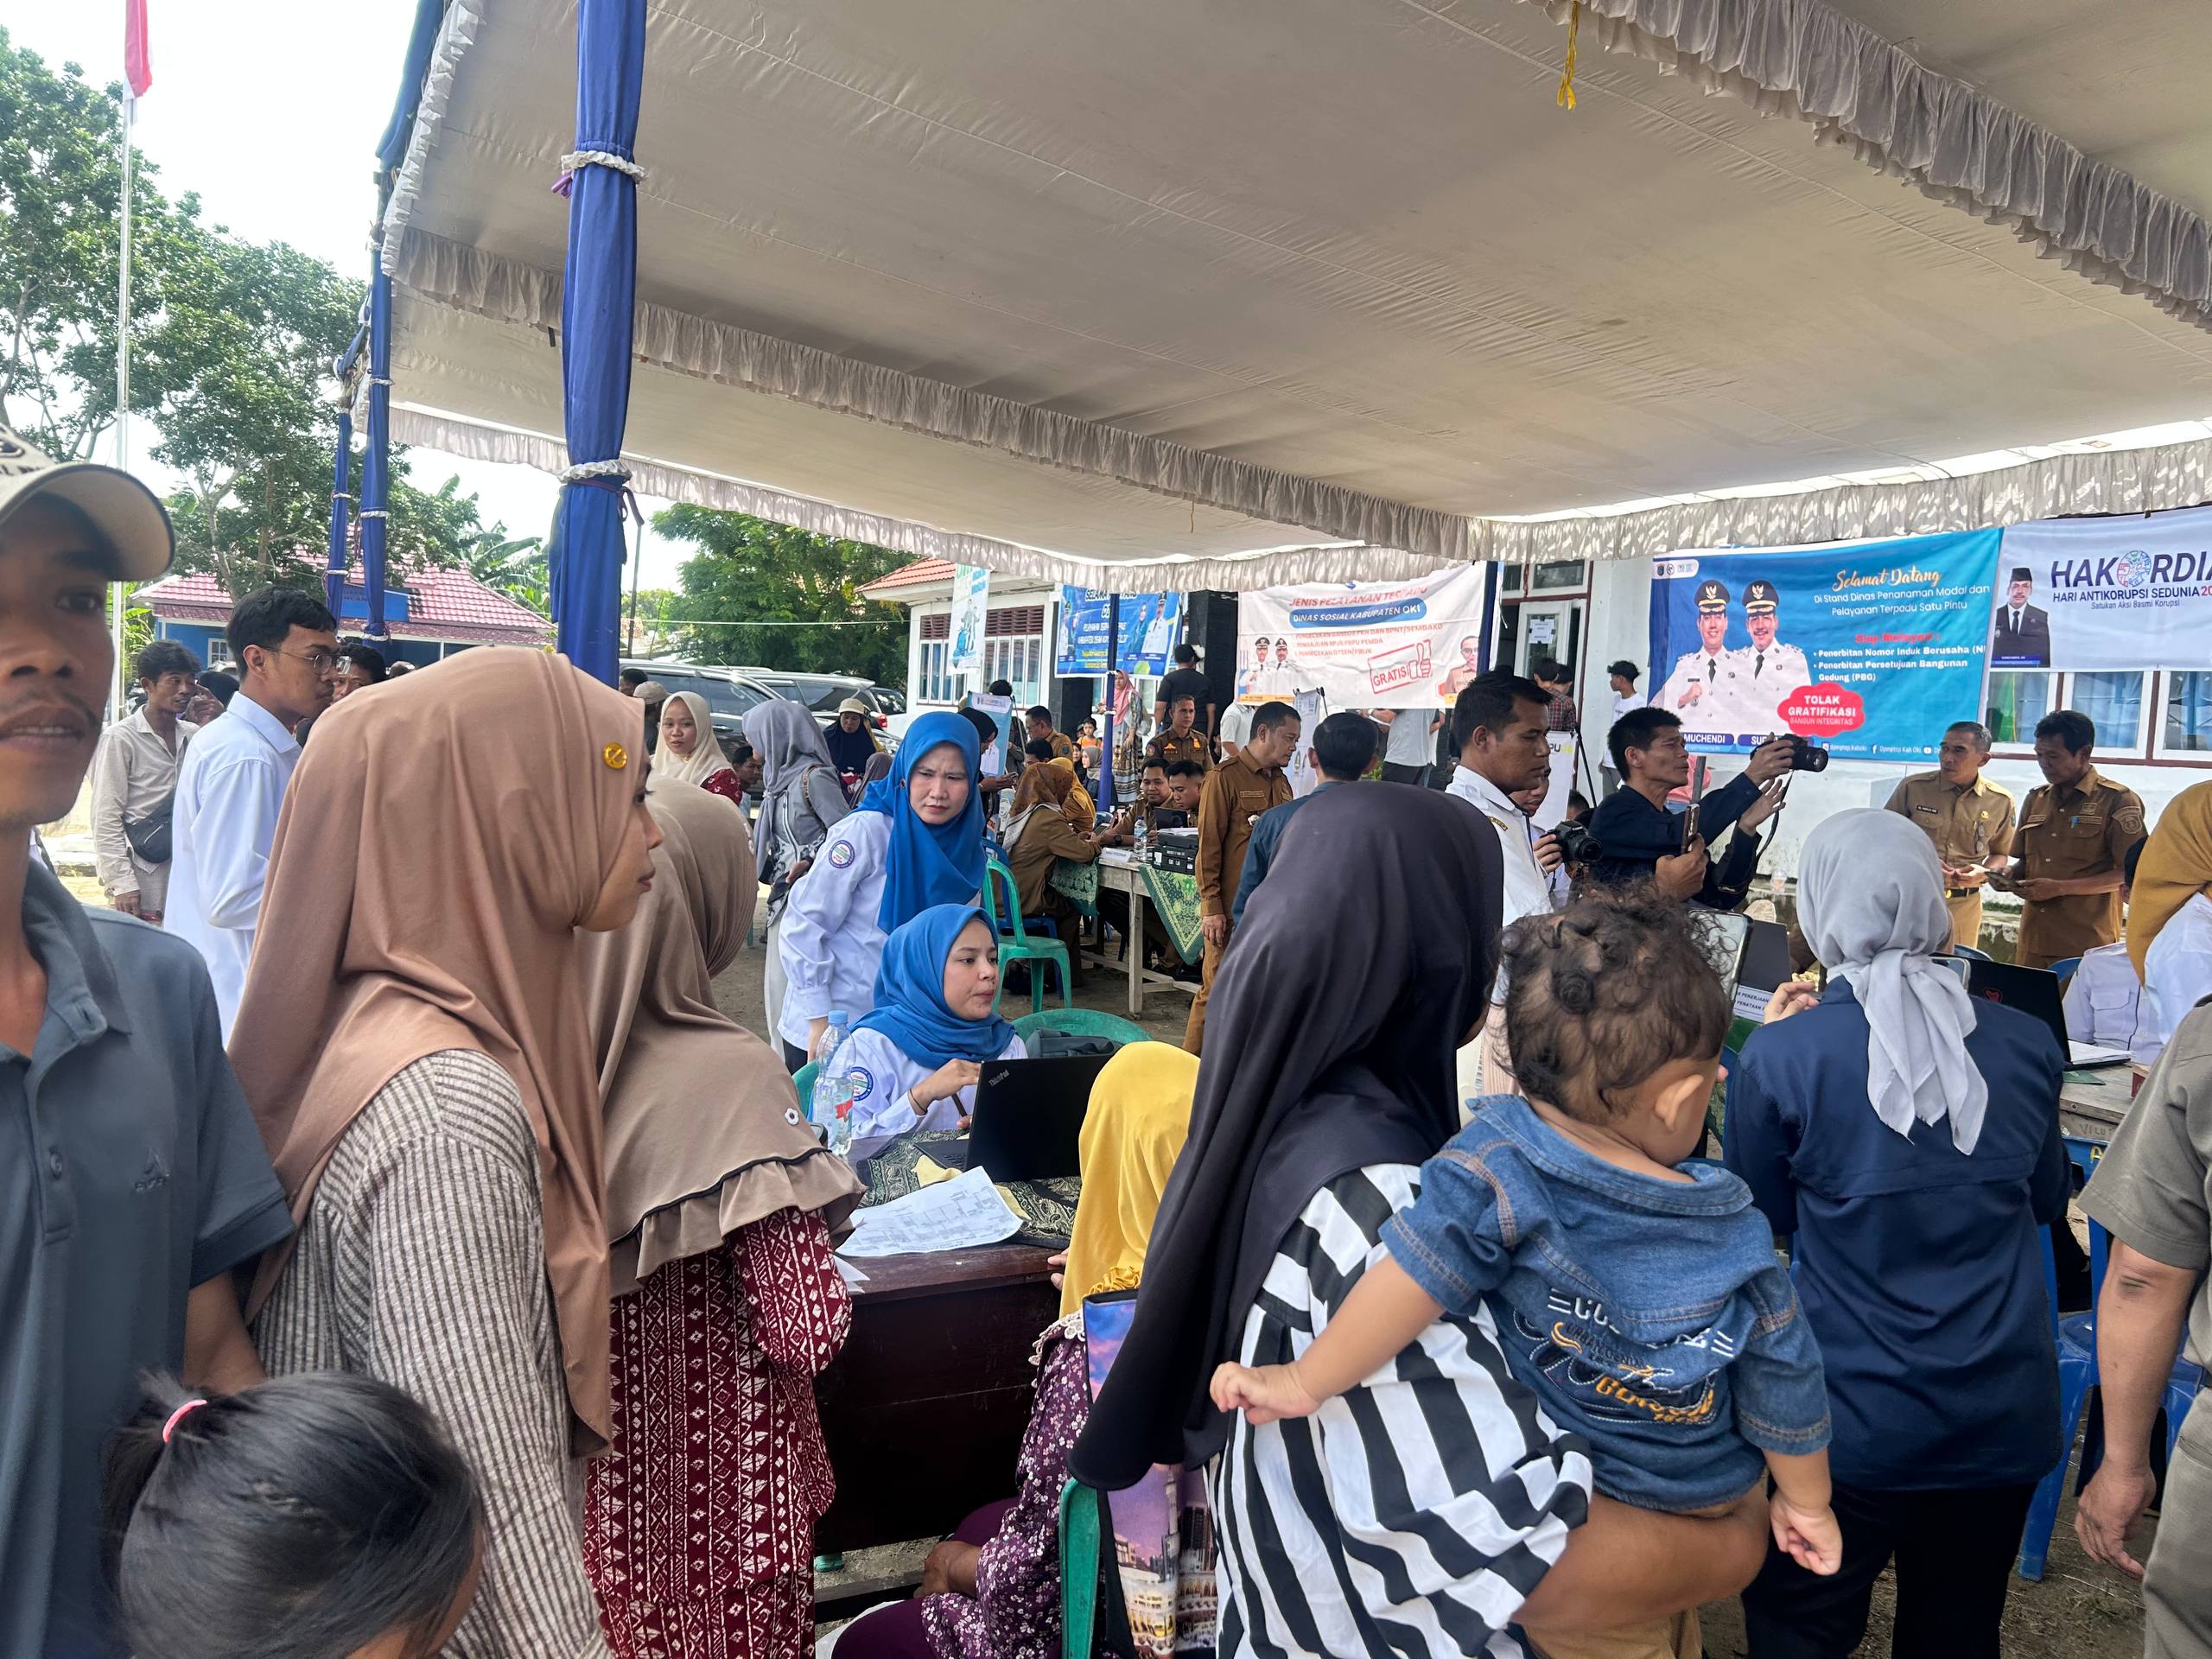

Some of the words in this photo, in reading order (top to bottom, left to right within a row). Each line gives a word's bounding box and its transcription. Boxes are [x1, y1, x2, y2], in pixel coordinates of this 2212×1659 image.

[1832, 568, 1888, 592] Selamat
[1888, 565, 1941, 588] Datang
[1814, 594, 1822, 603] Di
[1824, 593, 1849, 603] Stand
[1850, 592, 1876, 601] Dinas
[1877, 589, 1934, 601] Penanaman
[1936, 587, 1967, 596] Modal
[1968, 584, 1990, 594] dan
[2053, 592, 2077, 602] HARI
[2079, 588, 2149, 601] ANTIKORUPSI
[2151, 587, 2200, 599] SEDUNIA
[1289, 597, 1318, 607] JENIS
[2091, 601, 2116, 610] Satukan
[2118, 601, 2132, 609] Aksi
[2154, 599, 2180, 608] Korupsi
[1293, 613, 1319, 622] DINAS
[1319, 613, 1349, 621] SOSIAL
[1350, 607, 1401, 620] KABUPATEN
[1402, 604, 1421, 613] OKI
[1832, 604, 1878, 617] Pelayanan
[1879, 603, 1917, 615] Terpadu
[1919, 601, 1942, 611] Satu
[1944, 600, 1967, 609] Pintu
[1818, 649, 1863, 658] Penerbitan
[1866, 648, 1895, 657] Nomor
[1897, 647, 1921, 656] Induk
[1923, 646, 1969, 656] Berusaha
[1818, 661, 1863, 670] Penerbitan
[1866, 660, 1916, 671] Persetujuan
[1919, 659, 1968, 670] Bangunan
[1818, 673, 1850, 683] Gedung
[1804, 695, 1840, 705] TOLAK
[1788, 706, 1856, 717] GRATIFIKASI
[1816, 717, 1853, 726] INTEGRITAS
